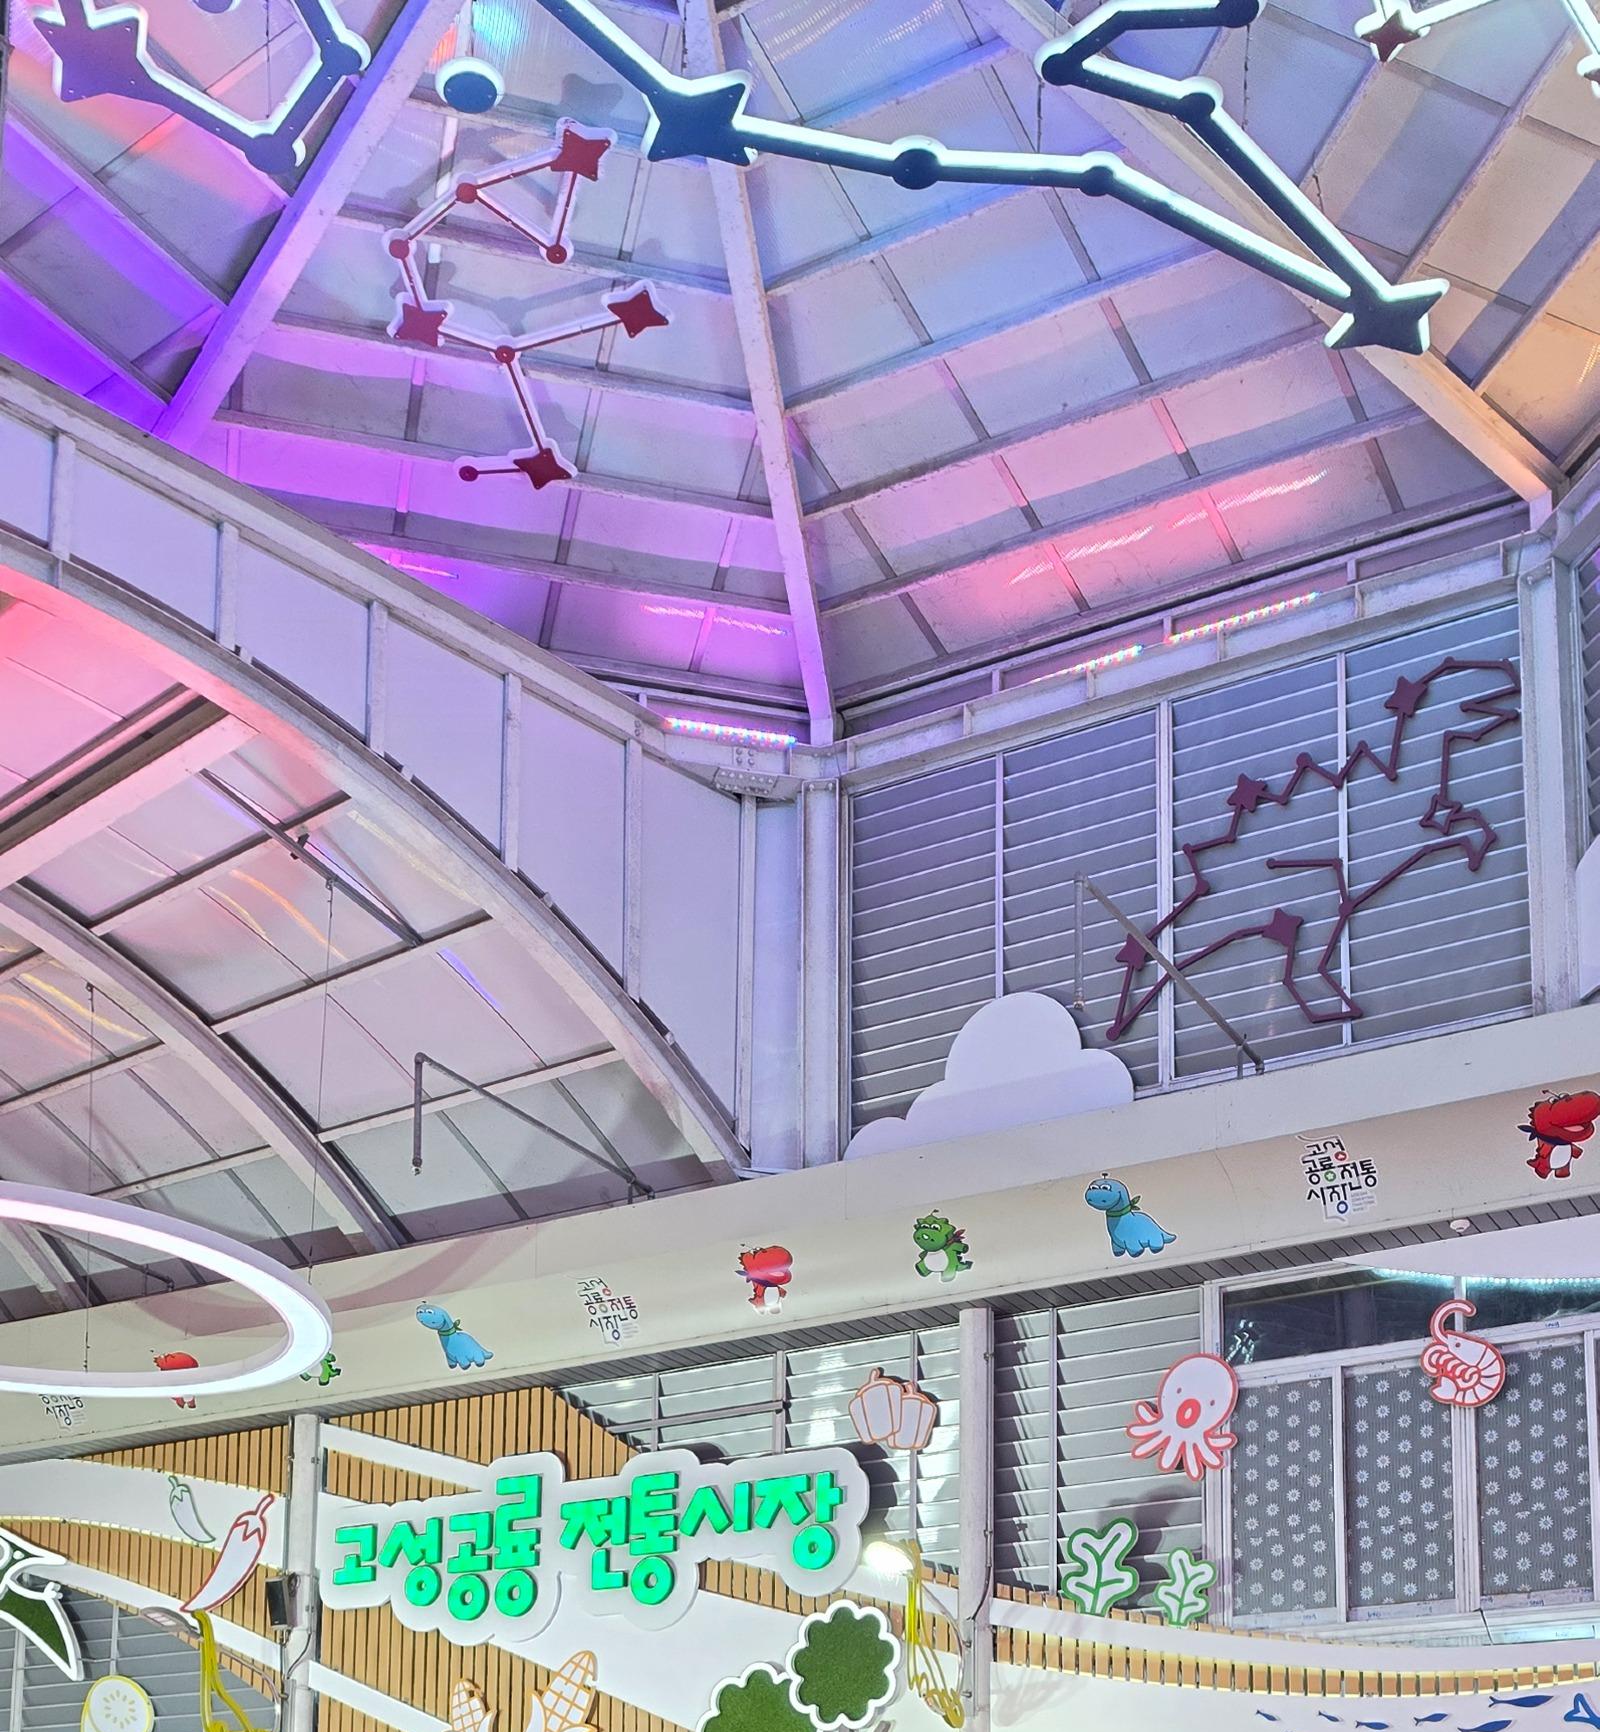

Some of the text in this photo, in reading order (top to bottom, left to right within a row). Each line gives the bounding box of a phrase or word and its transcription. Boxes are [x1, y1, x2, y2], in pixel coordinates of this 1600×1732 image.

[1305, 1138, 1347, 1161] 고성
[1307, 1183, 1348, 1214] 시장
[577, 1277, 612, 1297] 고성
[589, 1315, 620, 1341] 시장
[333, 1470, 843, 1621] 고성공룡 전통시장
